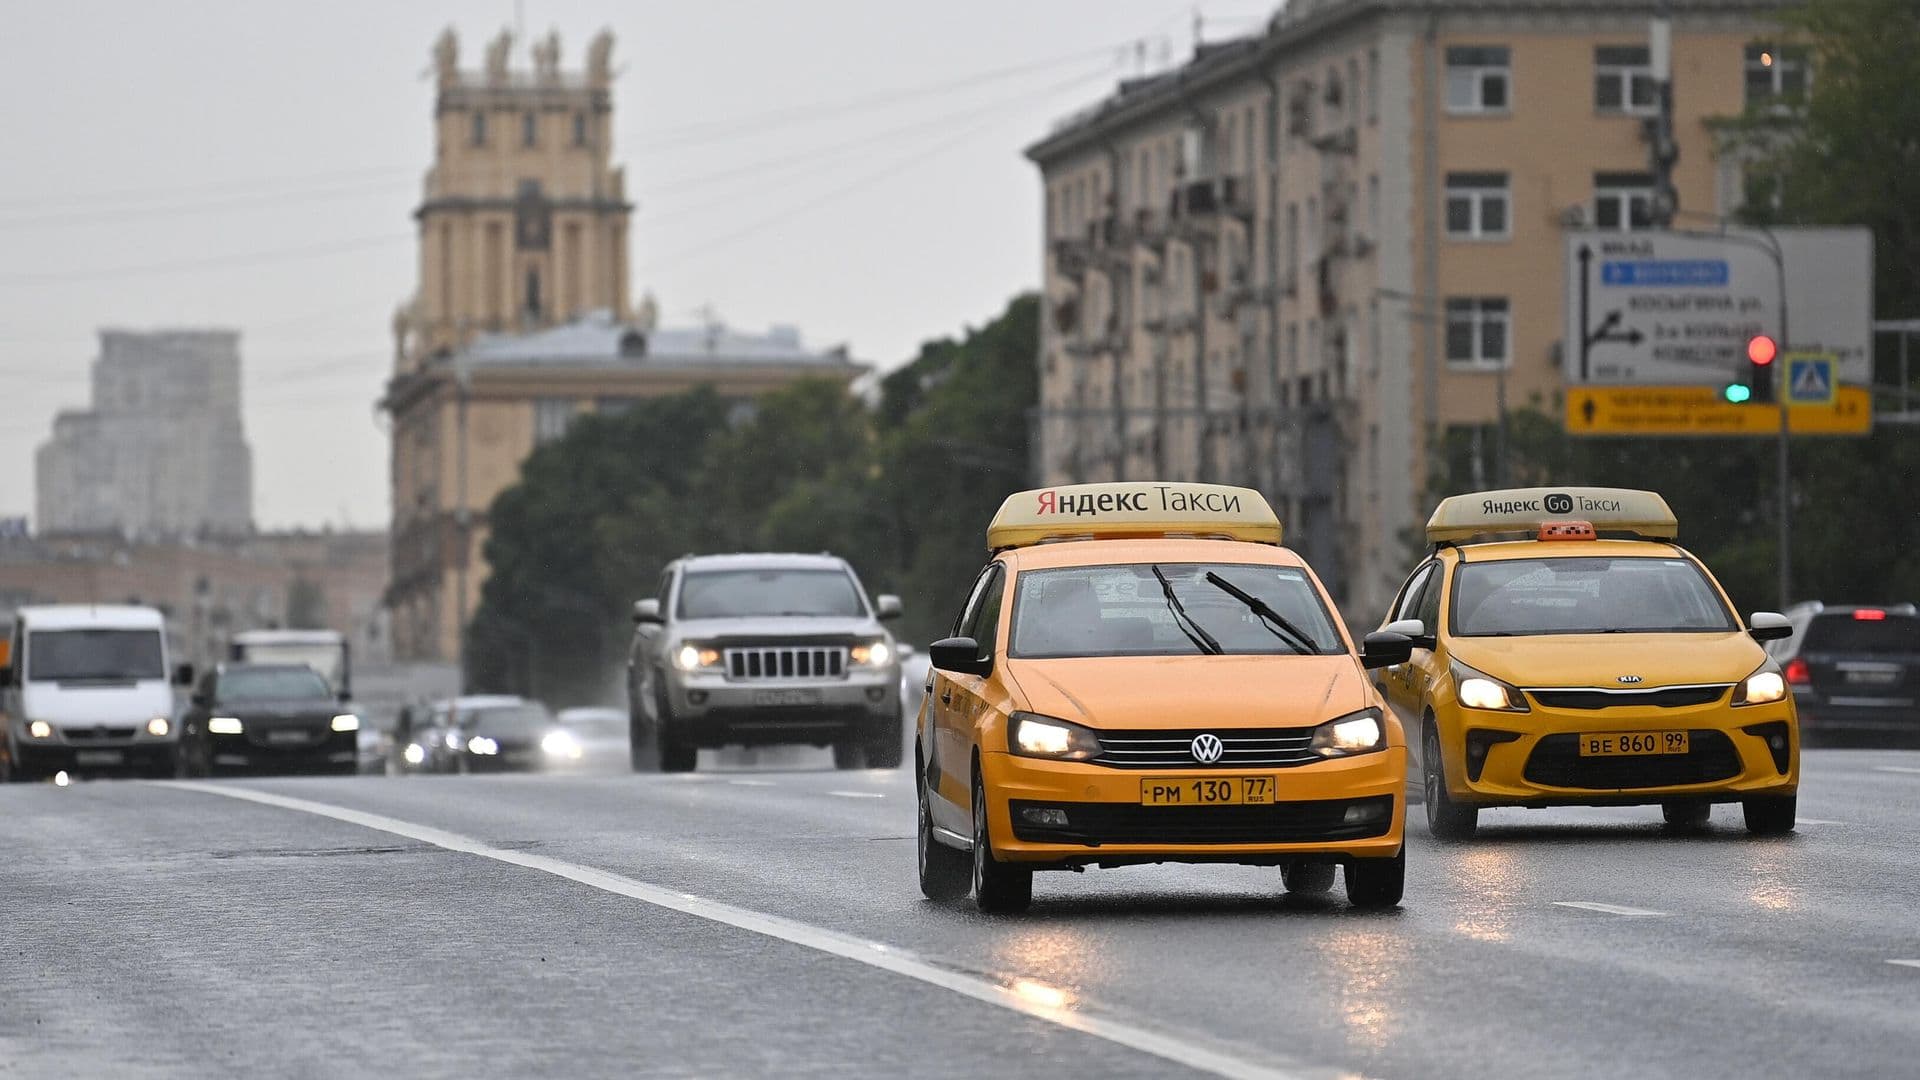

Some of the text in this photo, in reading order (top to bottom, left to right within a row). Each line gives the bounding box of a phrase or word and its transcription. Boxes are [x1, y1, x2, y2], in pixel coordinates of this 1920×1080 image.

[1036, 486, 1241, 516] Яндекс Такси
[1483, 496, 1621, 514] Яндекс Go Такси
[1620, 734, 1655, 752] 860
[1665, 733, 1683, 747] 99
[1191, 780, 1232, 802] 130
[1245, 779, 1267, 796] 77
